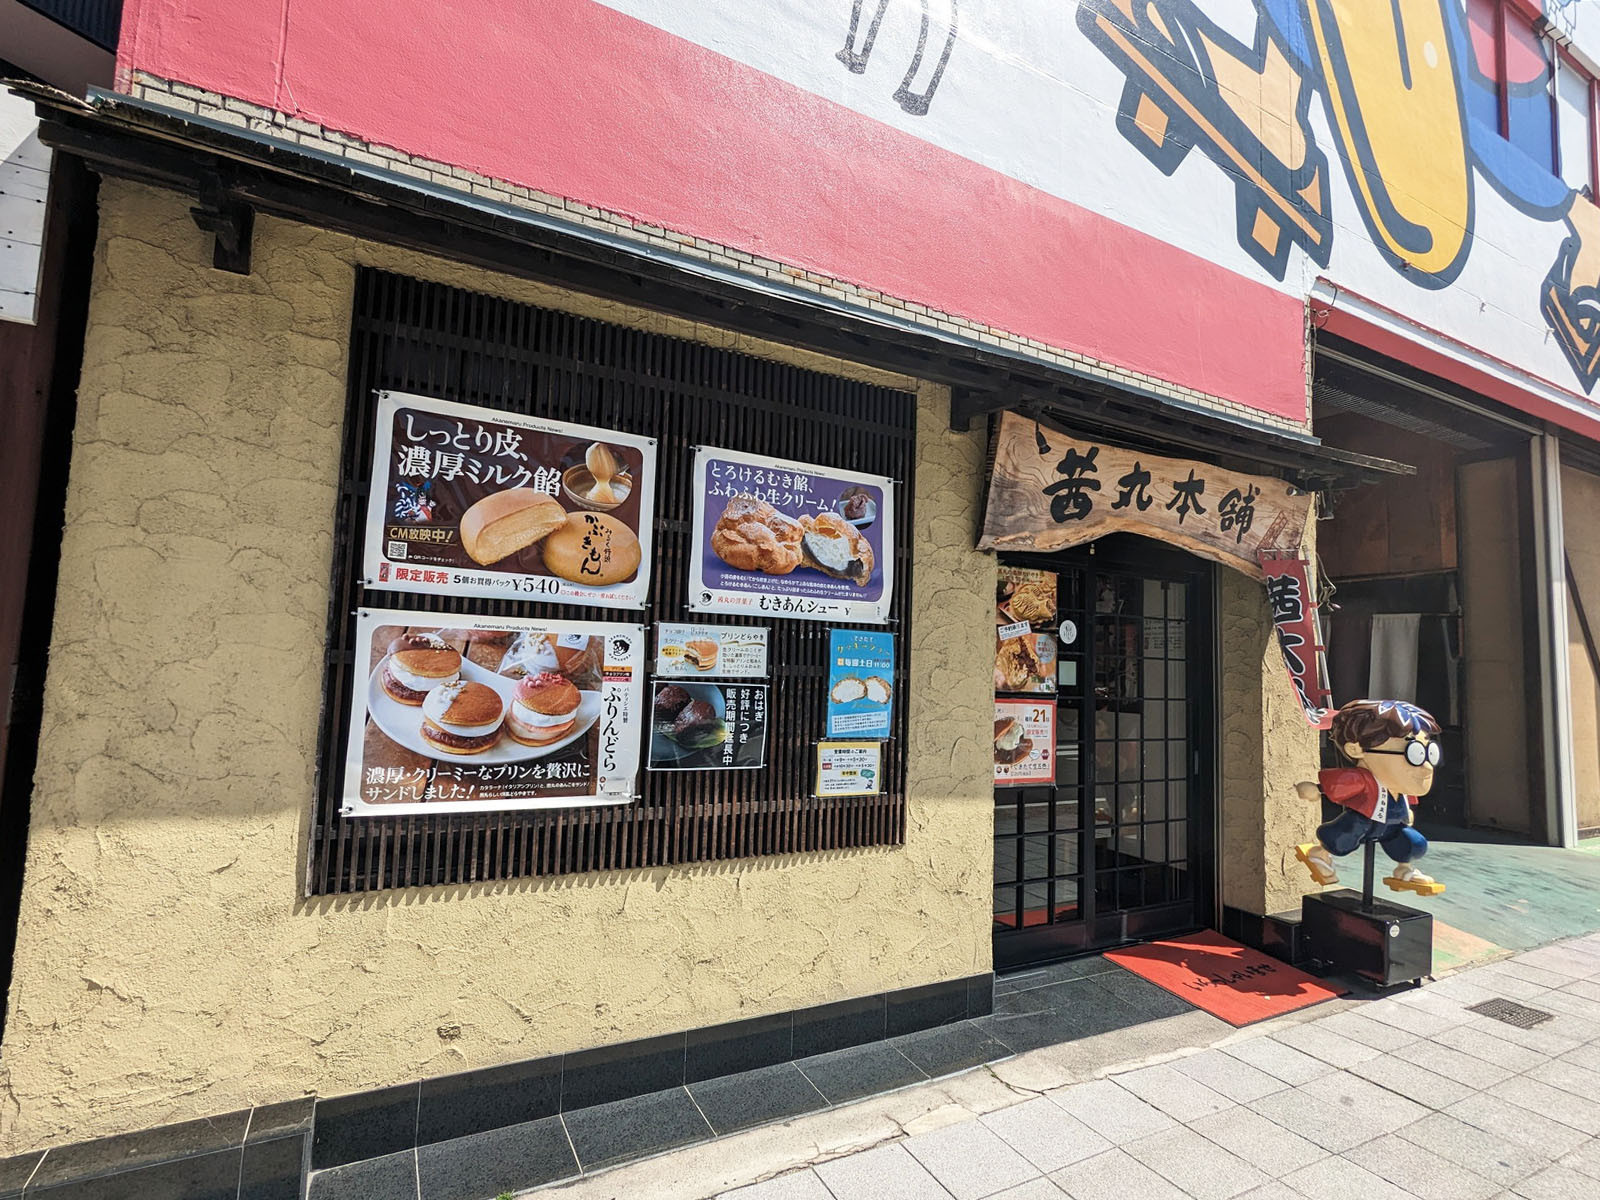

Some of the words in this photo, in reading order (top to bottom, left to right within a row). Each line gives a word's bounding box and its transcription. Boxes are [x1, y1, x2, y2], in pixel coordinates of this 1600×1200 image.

[406, 414, 528, 461] しっとり皮、
[397, 444, 563, 497] 濃厚ミルク餡
[711, 461, 813, 494] とろけるむき餡、
[1042, 446, 1260, 544] 茜丸本舗
[390, 527, 454, 543] CM放映中!
[395, 567, 449, 584] 限定販売
[759, 595, 839, 614] むきあんシュー
[739, 688, 751, 744] 好評につき
[754, 689, 765, 722] おはぎ
[603, 687, 621, 771] ぷりんどら
[722, 688, 737, 766] 販売期間延長中
[366, 762, 591, 785] 濃厚・クリーミーなプリンを贅沢に
[366, 783, 475, 801] サンドしました!
